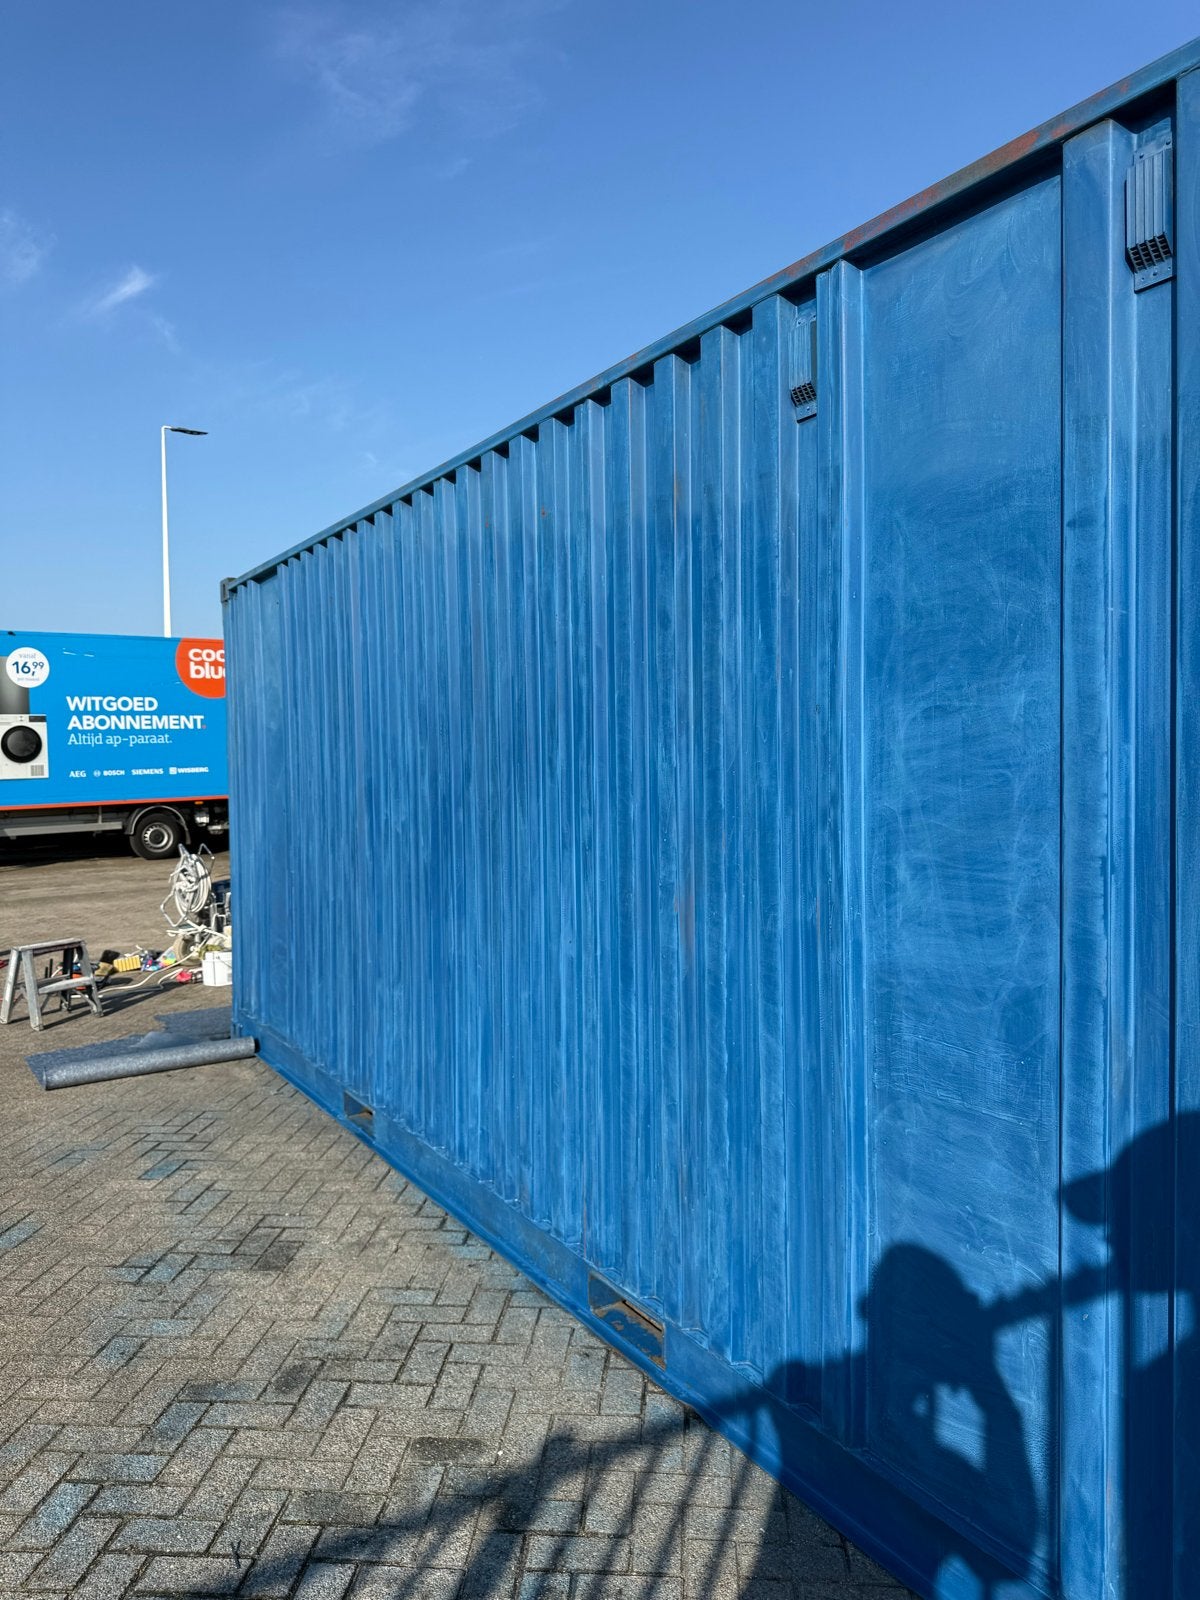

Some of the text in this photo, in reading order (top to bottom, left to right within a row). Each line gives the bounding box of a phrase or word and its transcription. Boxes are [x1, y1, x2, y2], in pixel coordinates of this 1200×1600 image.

[189, 661, 226, 679] blu
[66, 696, 158, 711] WITGOED
[67, 733, 173, 747] Altijd ap-paraat.
[69, 770, 87, 778] AEG
